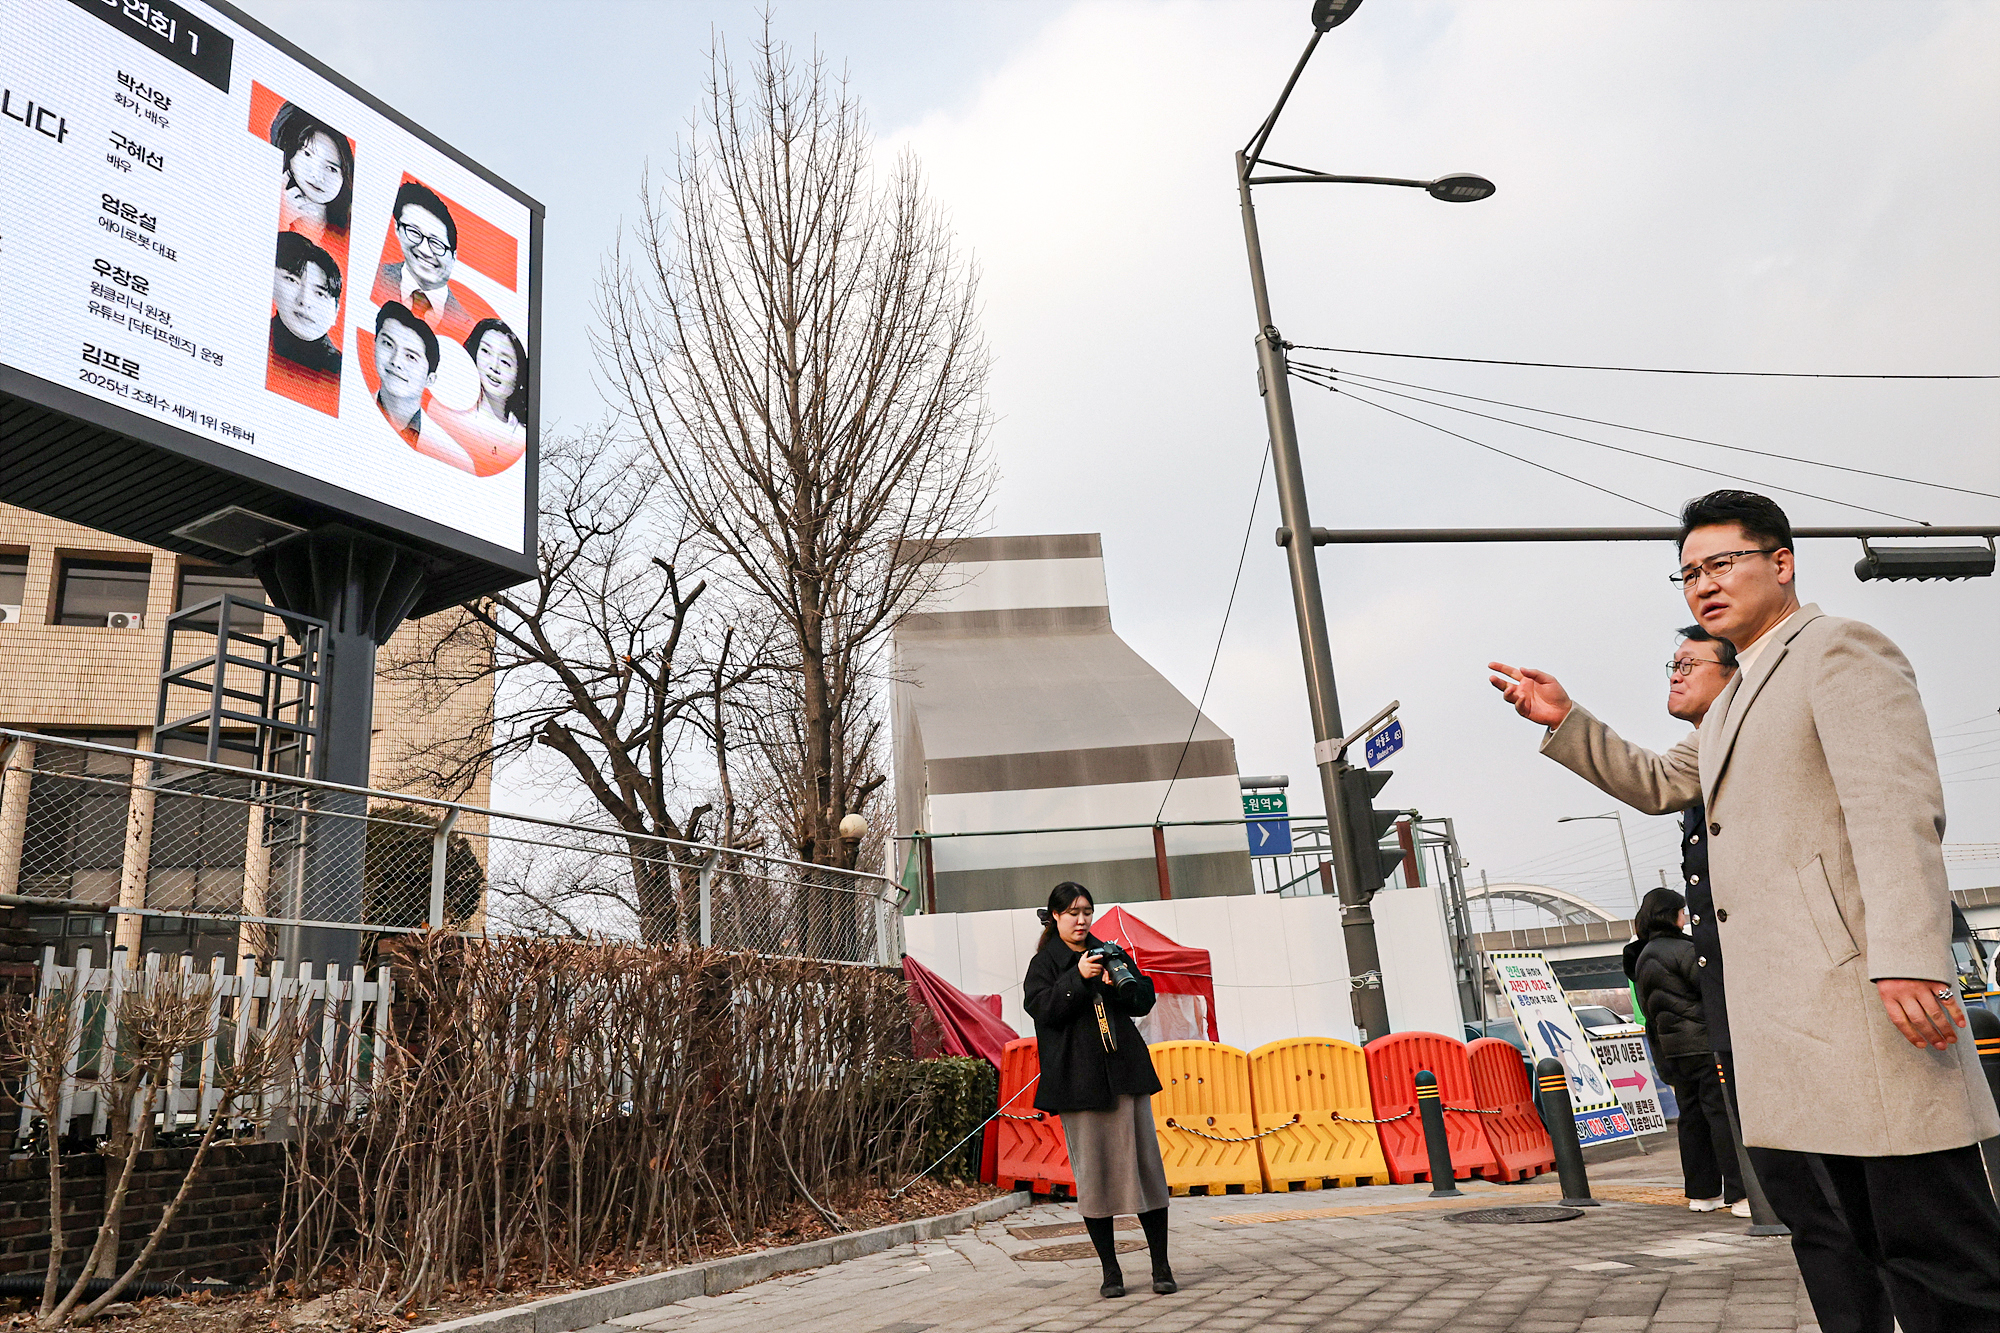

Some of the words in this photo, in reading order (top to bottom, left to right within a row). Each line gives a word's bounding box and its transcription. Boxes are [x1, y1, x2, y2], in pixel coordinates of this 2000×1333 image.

[187, 30, 199, 56] 1
[117, 69, 172, 111] 박신양
[114, 92, 142, 117] 화가,
[144, 108, 170, 129] 배우
[106, 153, 132, 173] 배우
[108, 130, 164, 172] 구혜선
[101, 193, 157, 233] 엄윤설
[98, 216, 150, 250] 에이로봇
[152, 241, 178, 262] 대표
[92, 258, 150, 296] 우창윤
[87, 300, 125, 325] 유튜브
[129, 317, 196, 358] [닥터프렌즈]
[200, 347, 223, 367] 운영
[145, 304, 173, 328] 원장,
[81, 342, 140, 381] 김프로
[79, 368, 129, 398] 2025년
[131, 387, 170, 410] 조회수
[172, 404, 197, 423] 세계
[200, 414, 217, 431] 1위
[219, 421, 255, 445] 유튜버
[1508, 980, 1532, 992] 자전거
[1620, 1042, 1646, 1063] 이동로
[1610, 1114, 1630, 1132] 통행
[1634, 1098, 1656, 1115] 불편을
